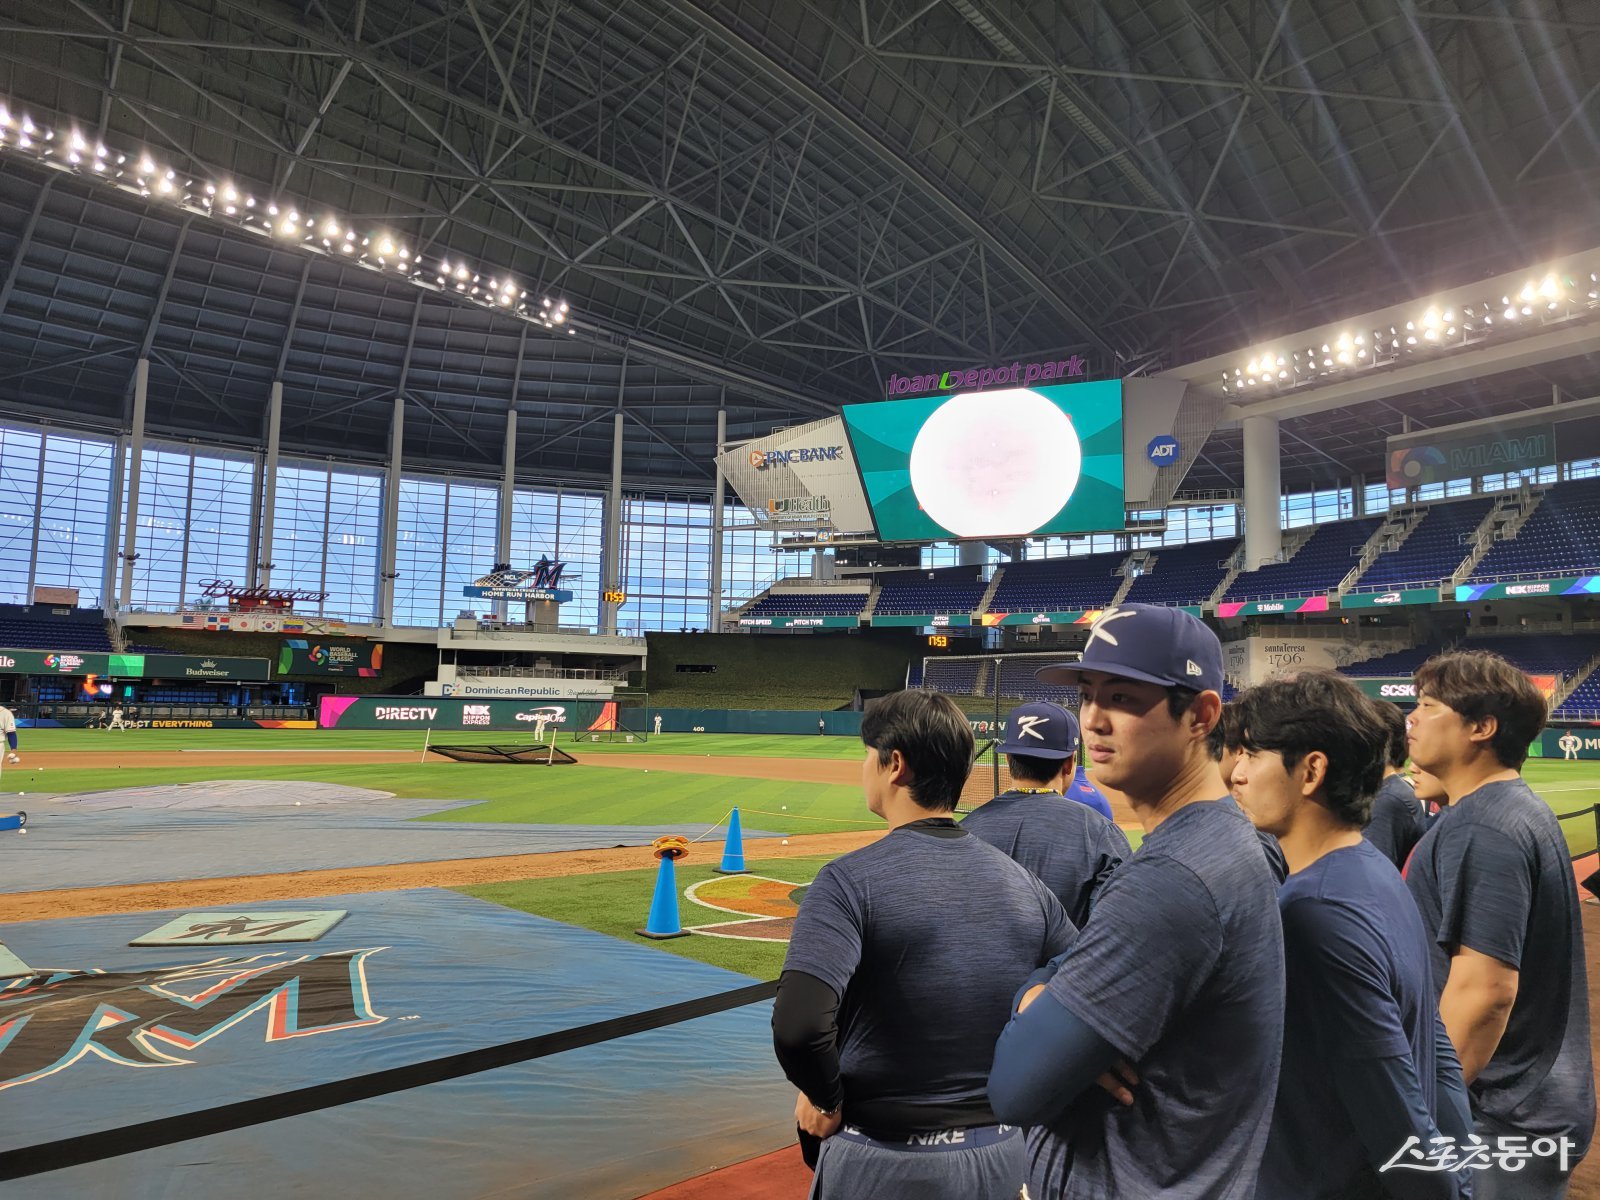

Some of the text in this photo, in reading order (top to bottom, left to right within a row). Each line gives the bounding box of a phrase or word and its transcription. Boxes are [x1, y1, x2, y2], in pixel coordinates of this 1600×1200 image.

[888, 354, 1086, 395] loanDepot park
[1150, 443, 1177, 458] ADT
[1451, 434, 1546, 471] MIAMI
[199, 579, 330, 601] Budweiser
[1264, 603, 1284, 611] Mobile
[929, 636, 947, 647] 17:53
[1268, 653, 1302, 668] 1796
[186, 668, 230, 677] Budweiser
[375, 707, 438, 720] DIRECTV
[152, 720, 213, 728] EVERYTHING
[907, 1127, 966, 1146] NIKE
